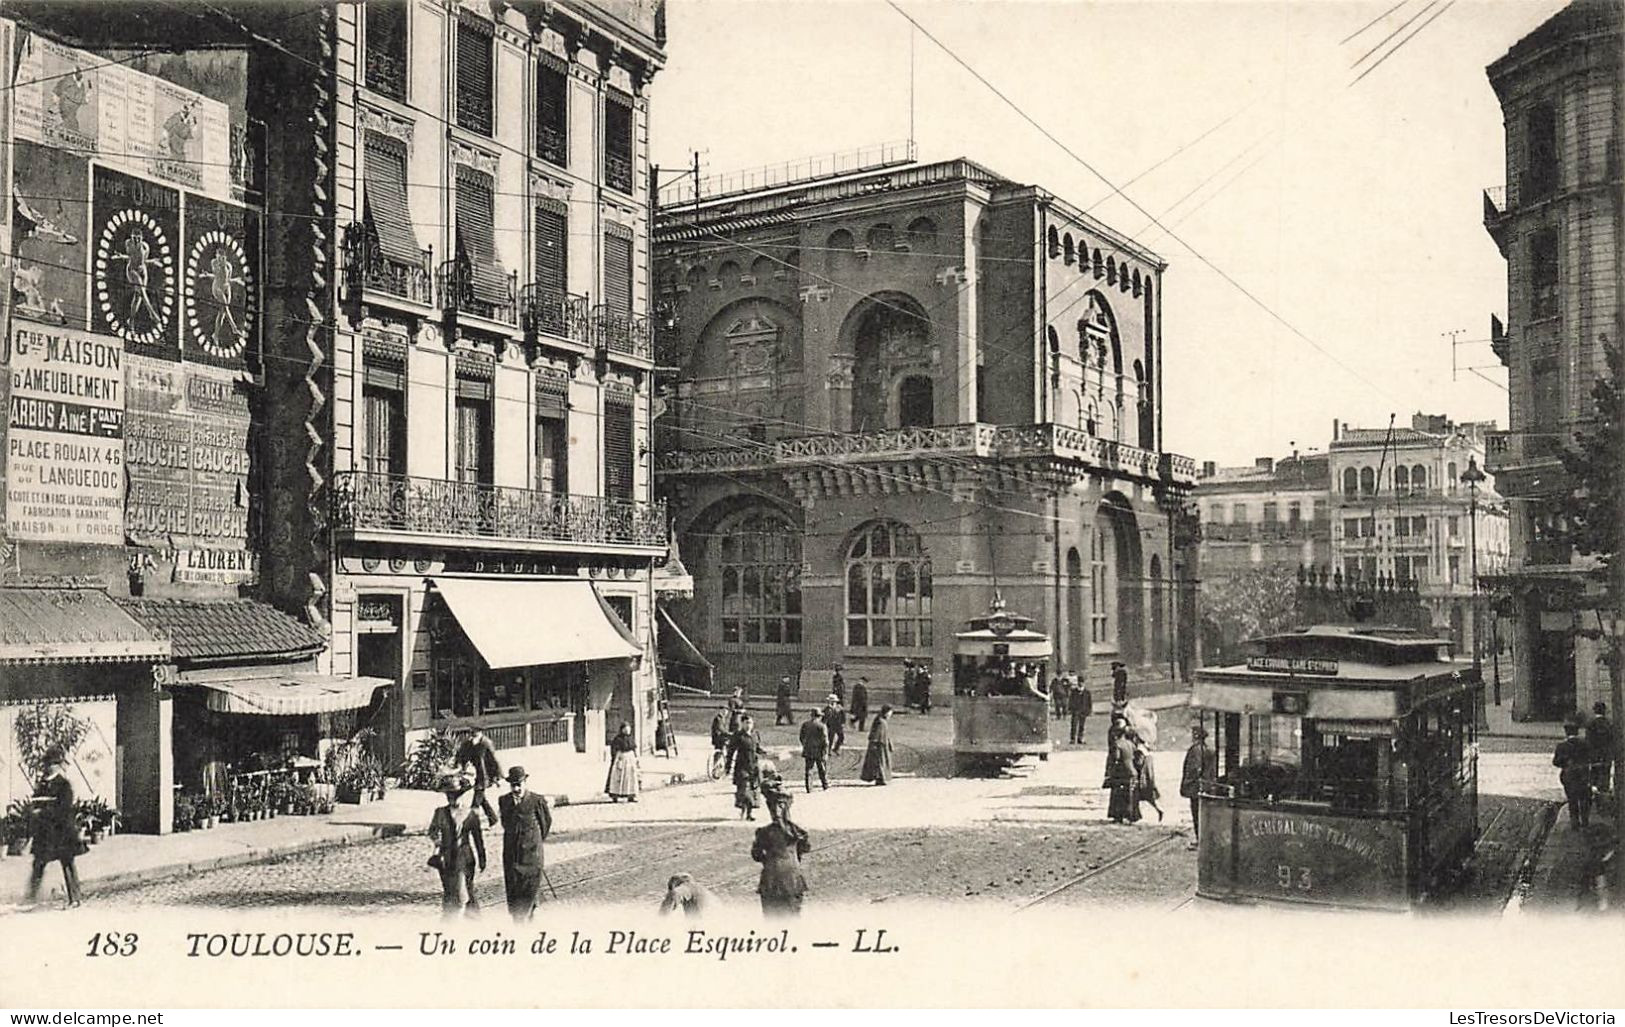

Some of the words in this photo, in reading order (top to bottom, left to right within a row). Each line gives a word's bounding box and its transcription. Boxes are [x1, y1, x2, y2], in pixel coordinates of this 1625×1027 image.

[44, 335, 121, 371] MAISON
[10, 397, 55, 428] ARBUS
[10, 438, 50, 459] PLACE
[54, 443, 100, 464] ROUAIX
[105, 447, 120, 465] 46
[40, 465, 118, 489] LANGUEDOC
[23, 506, 71, 519] FABRICATION
[75, 509, 109, 520] GARANTIE
[12, 521, 54, 534] MAISON
[1278, 864, 1312, 890] 93
